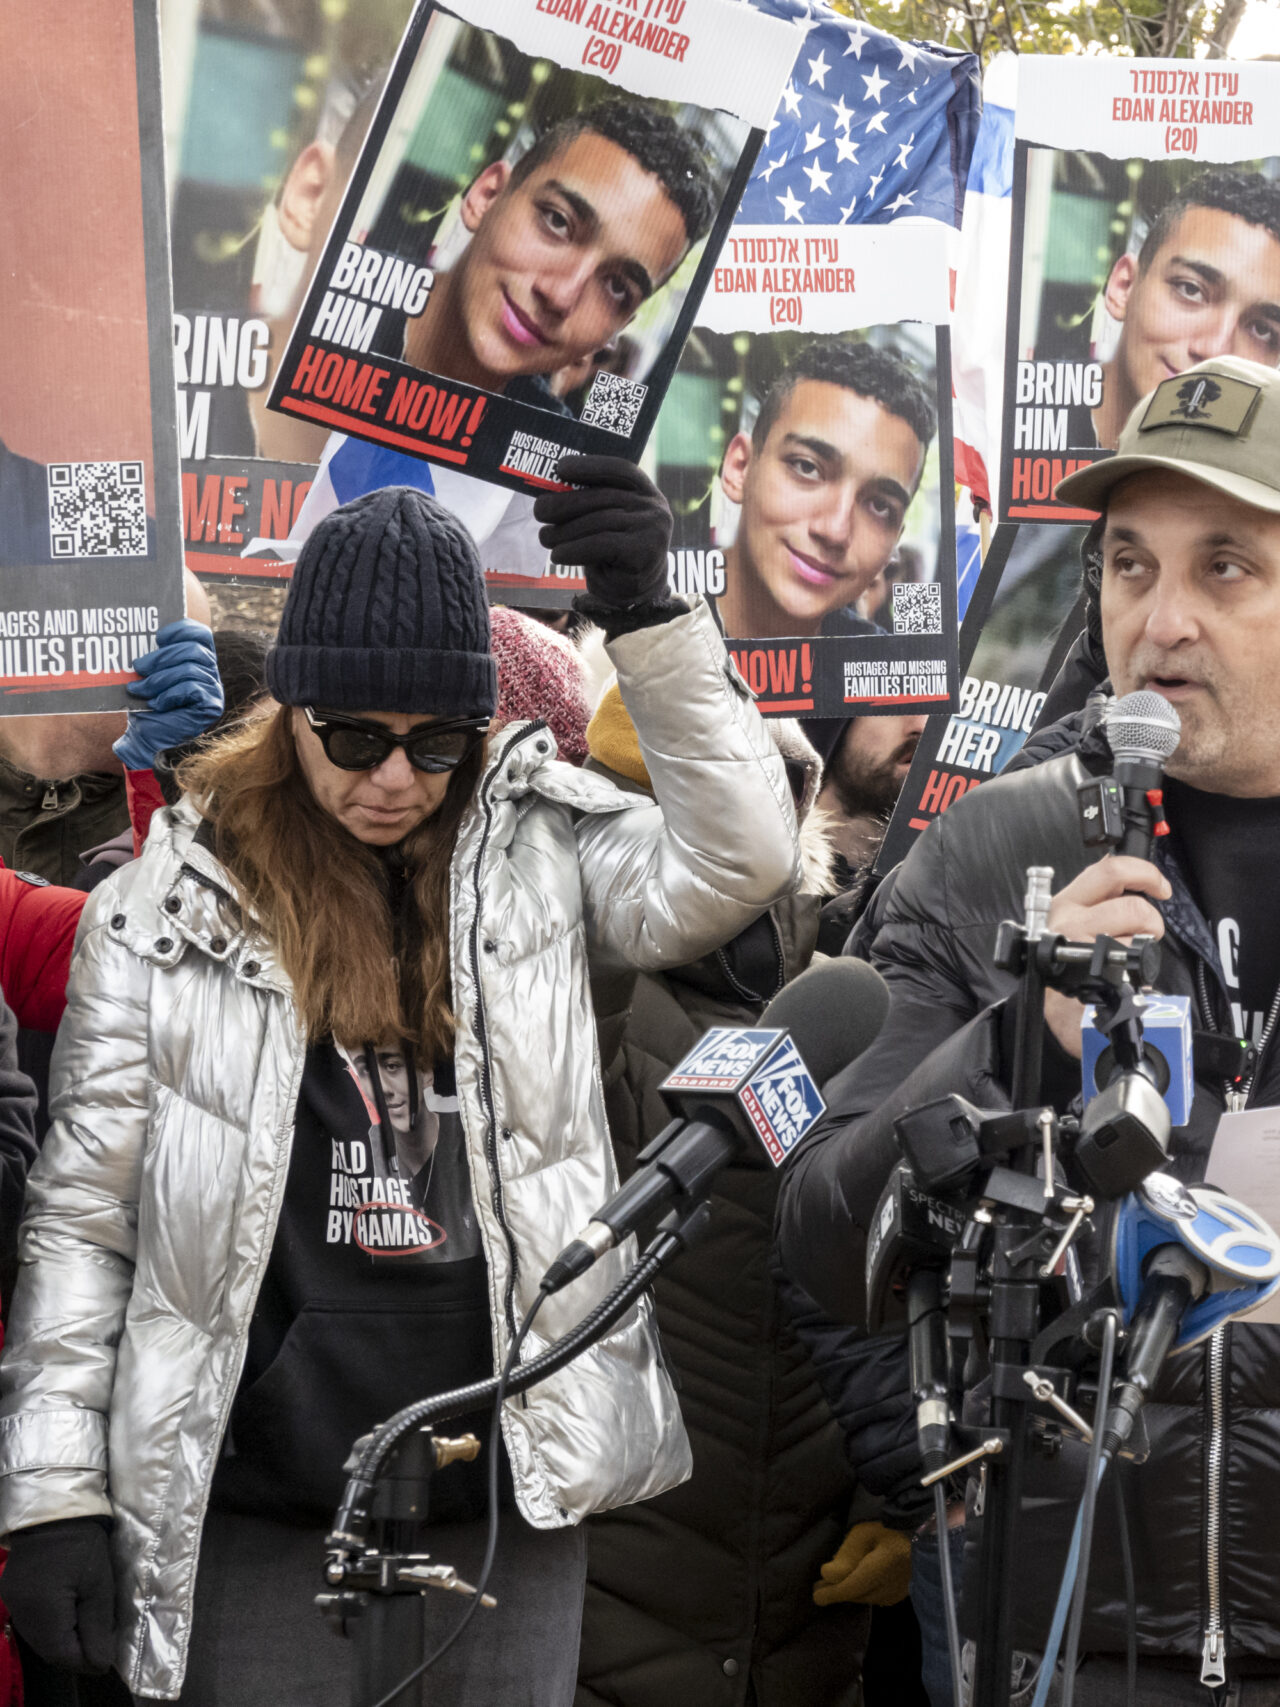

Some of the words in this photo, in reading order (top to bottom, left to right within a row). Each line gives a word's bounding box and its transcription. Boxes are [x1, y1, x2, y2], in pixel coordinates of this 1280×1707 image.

[585, 3, 691, 63] ALEXANDER
[581, 35, 623, 75] (20)
[1130, 69, 1199, 96] אלכסנדר
[1204, 72, 1239, 98] עידן
[1112, 97, 1155, 122] EDAN
[1159, 99, 1254, 126] ALEXANDER
[1165, 126, 1198, 155] (20)
[728, 236, 800, 263] אלכסנדר
[804, 238, 839, 266] עידן
[329, 242, 434, 315] BRING
[714, 268, 757, 293] EDAN
[762, 268, 856, 293] ALEXANDER
[310, 291, 383, 354] HIM
[770, 296, 803, 326] (20)
[291, 345, 390, 415] HOME
[385, 376, 488, 447] NOW!
[1015, 362, 1103, 406] BRING
[510, 430, 561, 460] HOSTAGES
[1014, 408, 1068, 451] HIM
[1012, 457, 1093, 501] HOM
[44, 609, 78, 636] AND
[82, 606, 159, 634] MISSING
[844, 661, 888, 677] HOSTAGES
[889, 661, 907, 676] AND
[908, 660, 947, 675] MISSING
[844, 676, 900, 698] FAMILIES
[902, 675, 948, 697] FORUM
[954, 676, 1049, 734] BRING
[935, 722, 1001, 773] HER
[686, 1059, 751, 1076] NEWS
[714, 1041, 766, 1061] FOX
[669, 1077, 736, 1087] channel
[757, 1078, 798, 1148] NEWS
[777, 1073, 812, 1133] FOX
[742, 1089, 782, 1159] channel
[329, 1173, 414, 1210] HOSTAGE
[326, 1209, 353, 1244] BY
[357, 1212, 432, 1247] HAMAS
